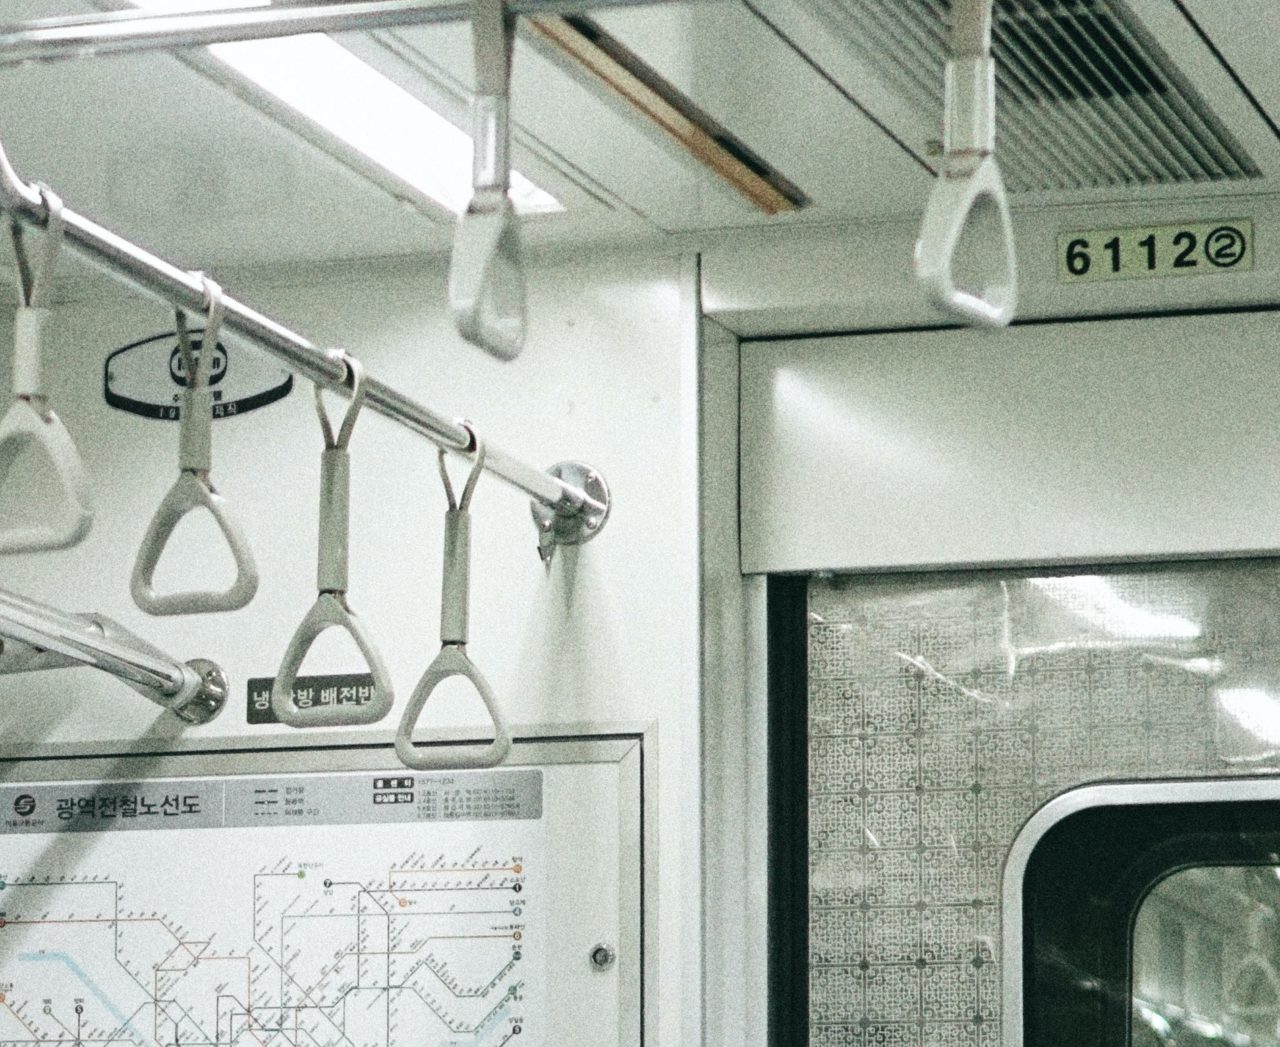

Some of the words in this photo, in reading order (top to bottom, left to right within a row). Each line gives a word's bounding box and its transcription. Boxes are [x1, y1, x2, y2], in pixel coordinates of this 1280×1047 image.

[1066, 231, 1197, 276] 6112
[253, 689, 315, 710] 냉방
[55, 794, 202, 821] 광역전철노선도
